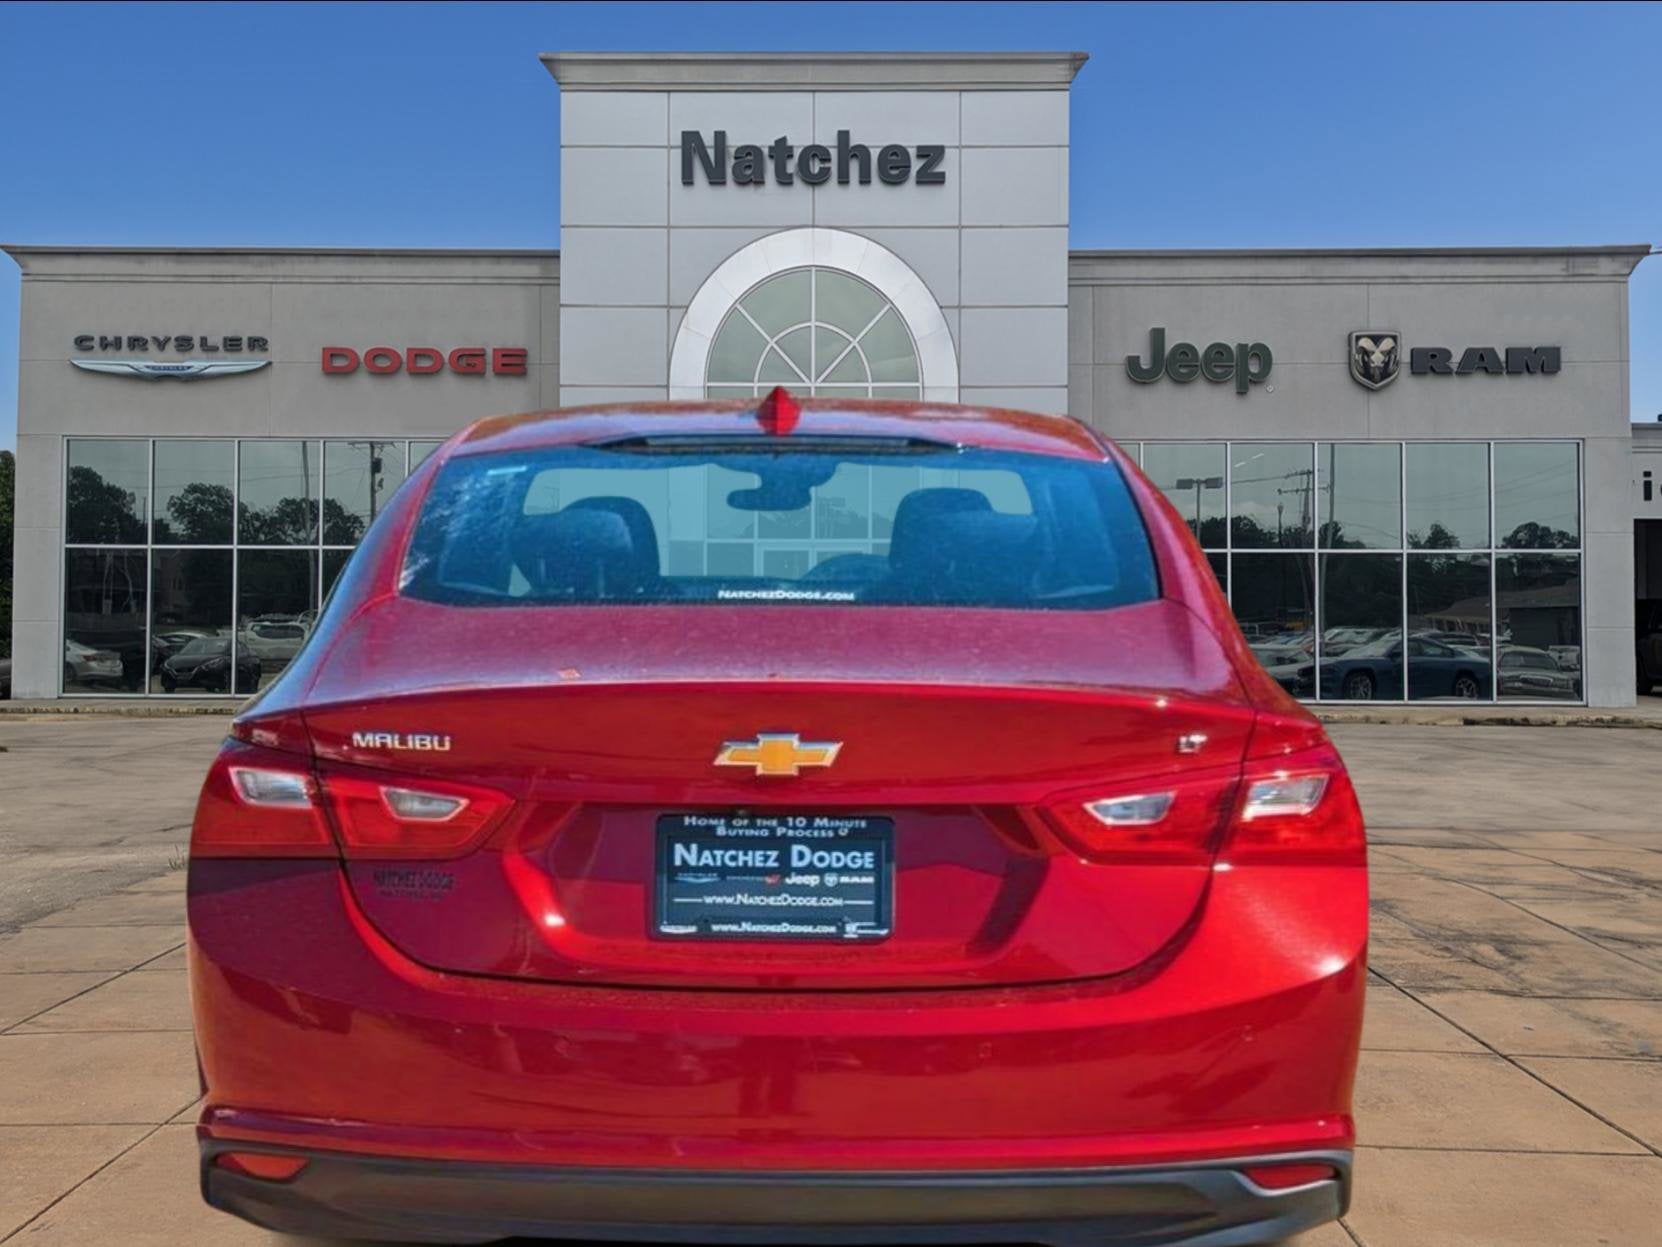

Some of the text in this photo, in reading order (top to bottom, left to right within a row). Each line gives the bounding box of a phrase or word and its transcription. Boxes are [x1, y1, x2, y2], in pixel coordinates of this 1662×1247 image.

[681, 131, 945, 188] Natchez
[74, 335, 268, 353] CHRYSLER
[321, 346, 527, 376] DODGE
[1126, 328, 1273, 396] Jeep
[1410, 346, 1561, 375] RAM
[352, 732, 451, 751] MALIBU
[683, 815, 867, 829] HOME OF THE 10 MINUTE
[716, 826, 835, 838] BUYING PROCESS
[674, 843, 875, 869] NATCHEZ DODGE
[785, 872, 820, 887] Jeep
